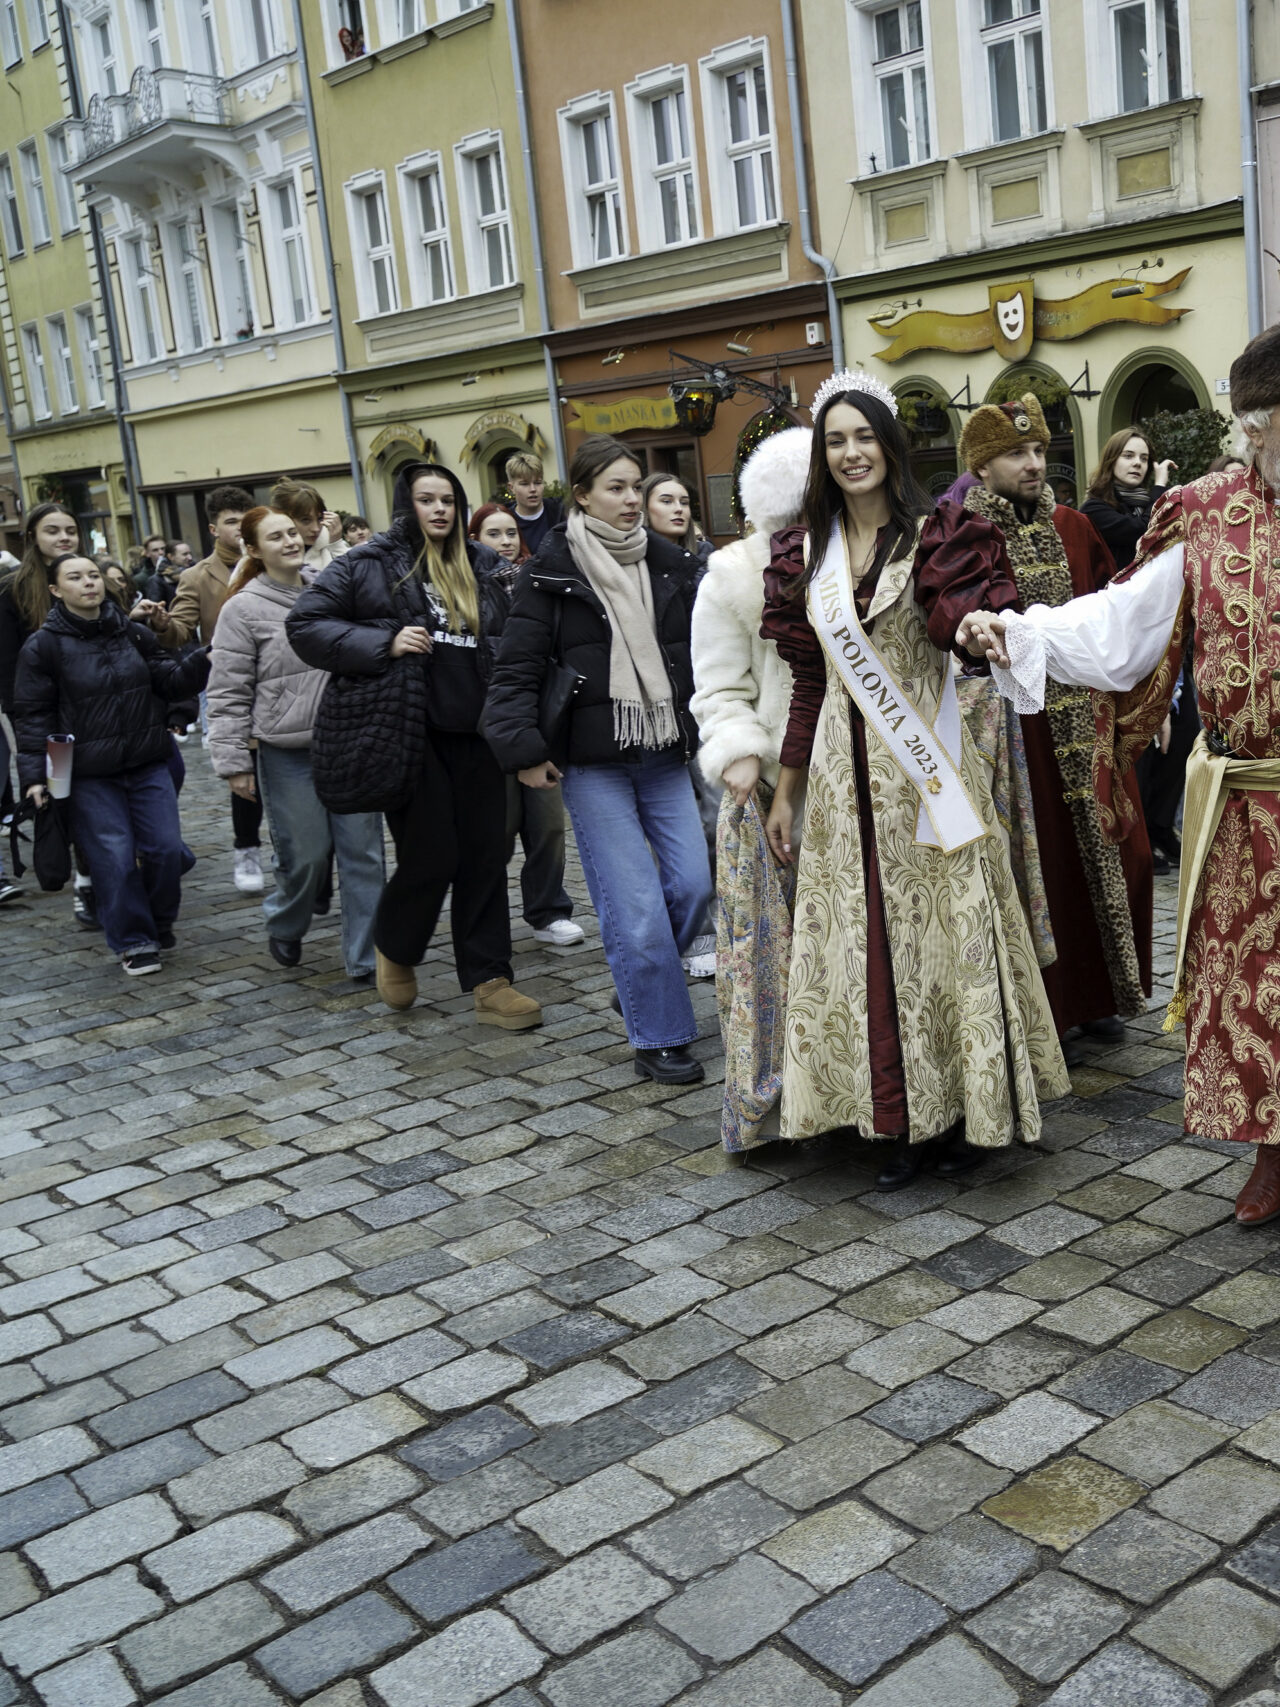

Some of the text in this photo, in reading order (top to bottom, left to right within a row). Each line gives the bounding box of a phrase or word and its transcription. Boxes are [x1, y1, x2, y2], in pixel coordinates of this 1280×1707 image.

[818, 571, 938, 775] MISS POLONIA 2023
